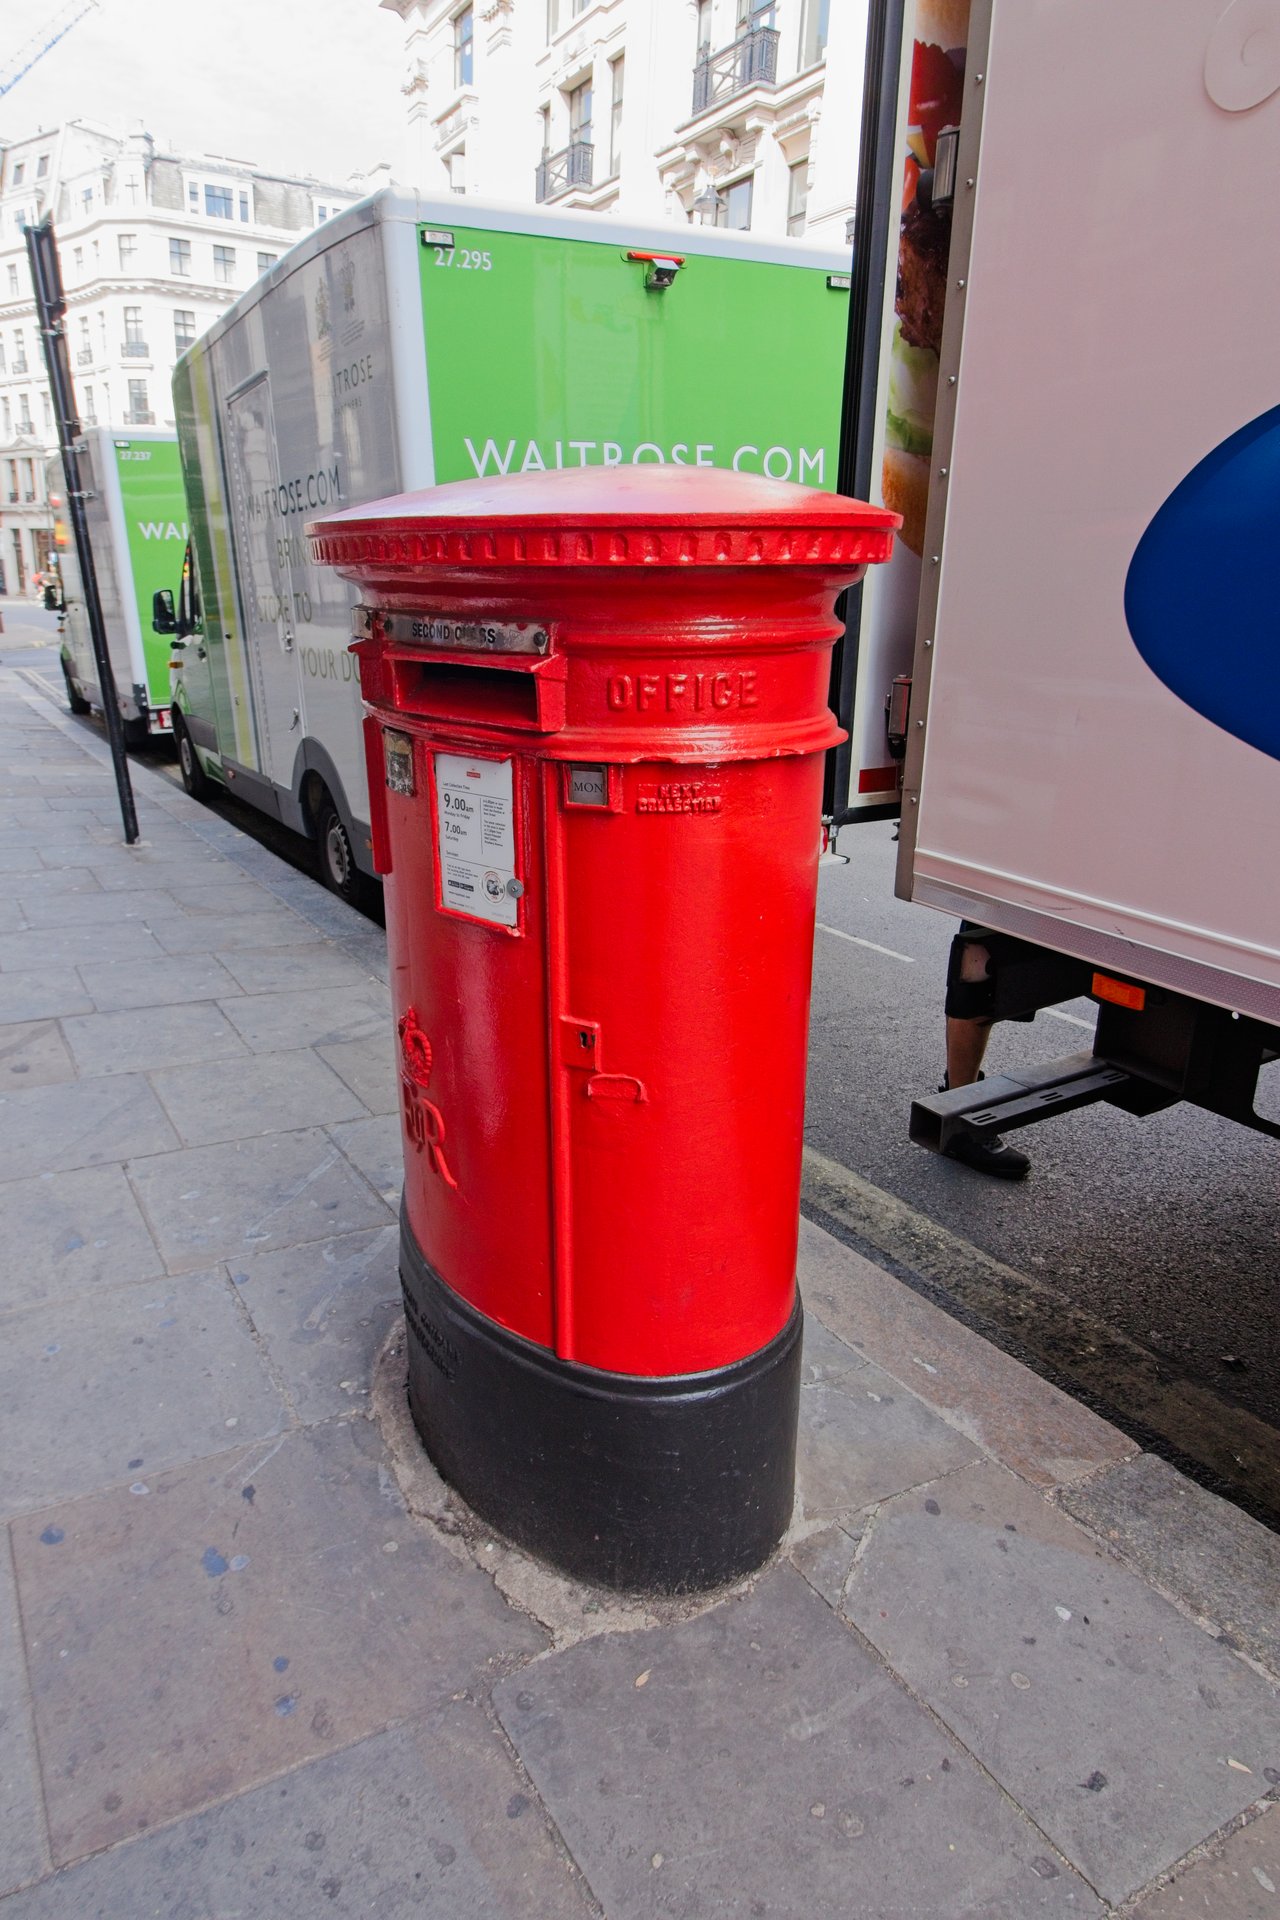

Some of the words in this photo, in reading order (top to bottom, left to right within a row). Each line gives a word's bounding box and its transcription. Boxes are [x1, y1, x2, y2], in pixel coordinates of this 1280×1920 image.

[434, 246, 492, 271] 27.295
[332, 354, 373, 398] ITROSE
[118, 451, 152, 461] 27.237
[246, 465, 341, 523] WAITROSE.COM
[137, 521, 188, 541] WAI
[277, 536, 309, 569] BRIN
[293, 592, 312, 623] TO
[412, 622, 450, 640] SECOND
[299, 647, 338, 681] YOUR
[341, 649, 361, 684] DO
[606, 672, 758, 712] OFFICE
[574, 781, 604, 793] MON
[443, 793, 474, 813] 9.00am
